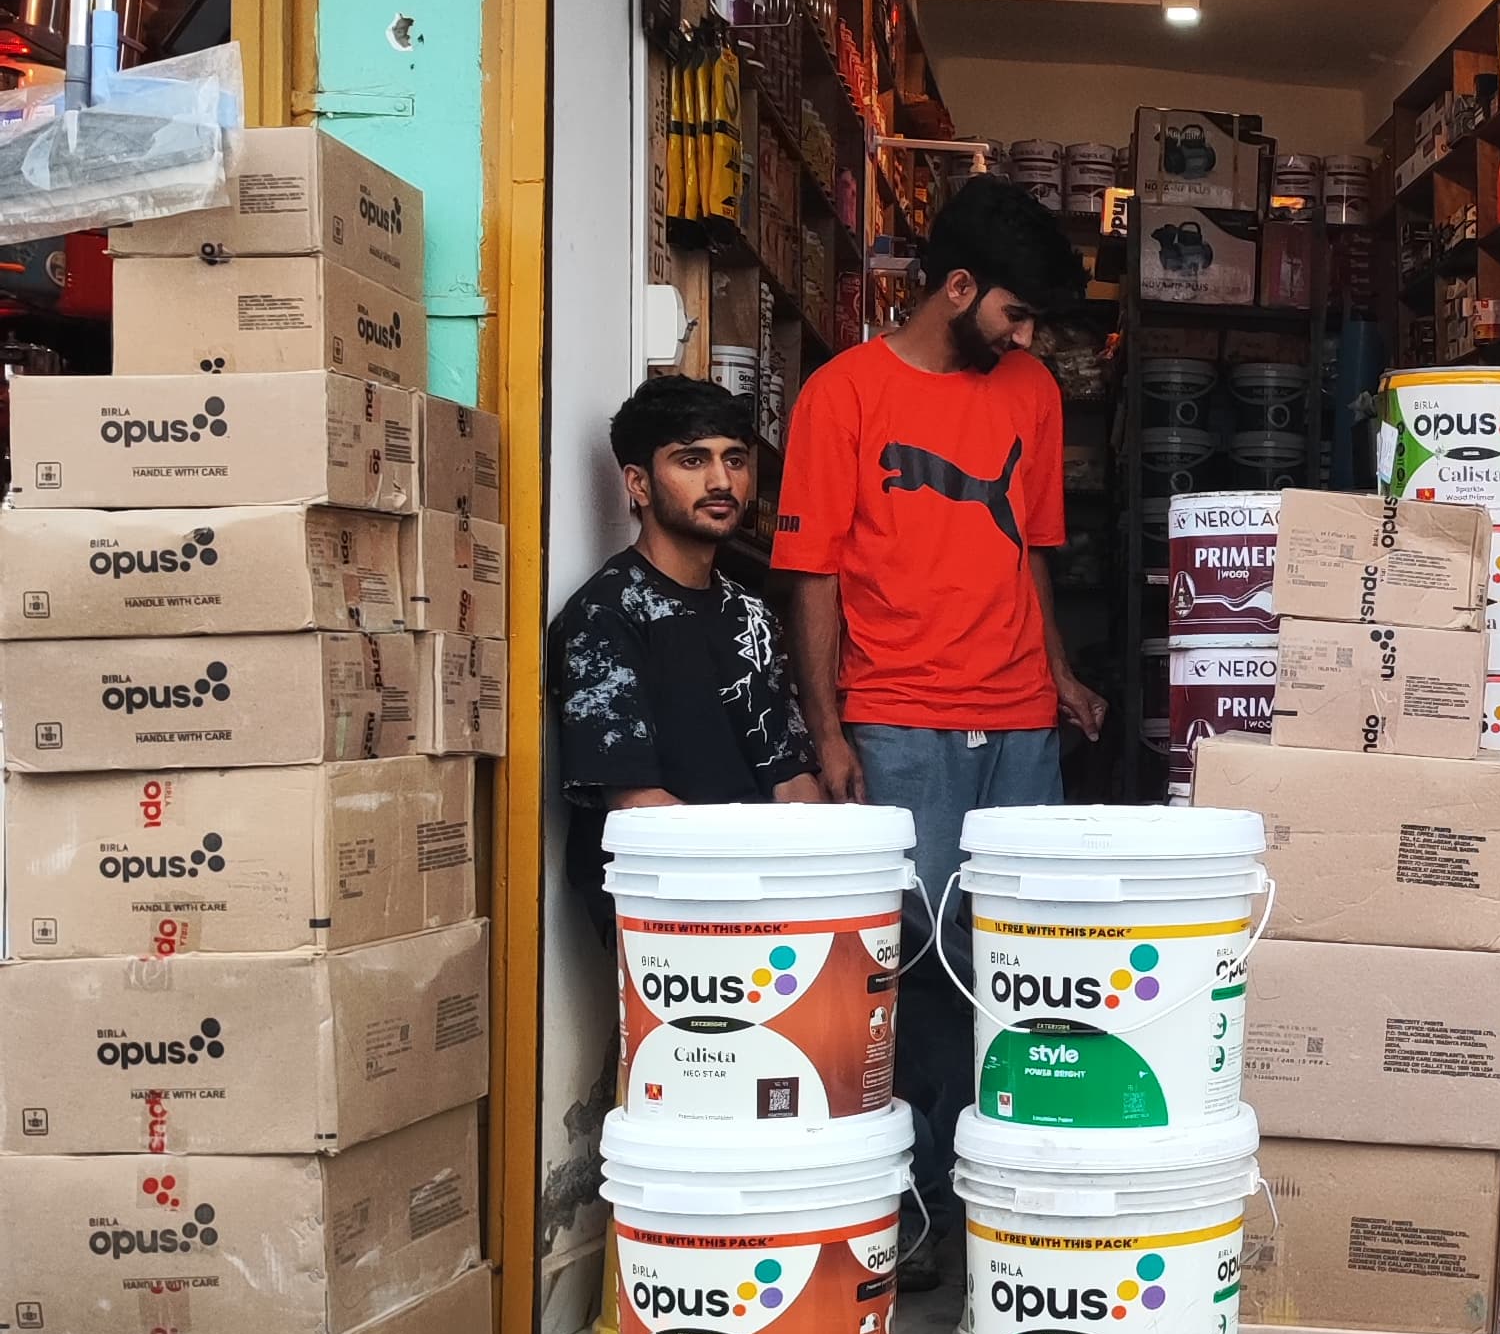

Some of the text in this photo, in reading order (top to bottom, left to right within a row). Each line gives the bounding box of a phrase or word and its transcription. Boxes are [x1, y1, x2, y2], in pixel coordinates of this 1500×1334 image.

[1414, 401, 1439, 410] BIRLA
[101, 408, 130, 416] BIRLA
[1414, 413, 1496, 440] opus
[101, 419, 189, 447] opus
[133, 467, 228, 477] HANDLE WITH CARE
[90, 539, 119, 548] BIRLA
[90, 549, 178, 579] opus
[125, 596, 221, 608] HANDLE WITH CARE
[102, 675, 131, 684] BIRLA
[102, 685, 191, 714] opus
[136, 731, 232, 743] HANDLE WITH CARE
[100, 844, 128, 852] BIRLA
[100, 855, 187, 883] opus
[174, 903, 227, 911] WITH CARE
[652, 922, 742, 933] FREE WITH THIS
[1003, 924, 1087, 936] FREE WITH THIS
[642, 956, 670, 968] BIRLA
[991, 952, 1020, 966] BIRLA
[642, 973, 745, 1008] opus
[992, 970, 1101, 1011] opus
[97, 1029, 127, 1038] BIRLA
[97, 1040, 185, 1069] opus
[674, 1047, 736, 1064] Calista
[1029, 1045, 1079, 1066] style
[703, 1070, 726, 1078] STAR
[1024, 1068, 1086, 1078] POWER BRIGHT
[173, 1089, 226, 1099] WITH CARE
[89, 1218, 118, 1227] BIRLA
[89, 1229, 179, 1259] opus
[665, 1236, 726, 1247] WITH THIS
[1029, 1237, 1092, 1248] WITH THIS
[632, 1264, 658, 1279] BIRLA
[991, 1260, 1023, 1278] BIRLA
[192, 1277, 219, 1287] CARE
[634, 1282, 730, 1318] opus
[991, 1280, 1108, 1322] opus
